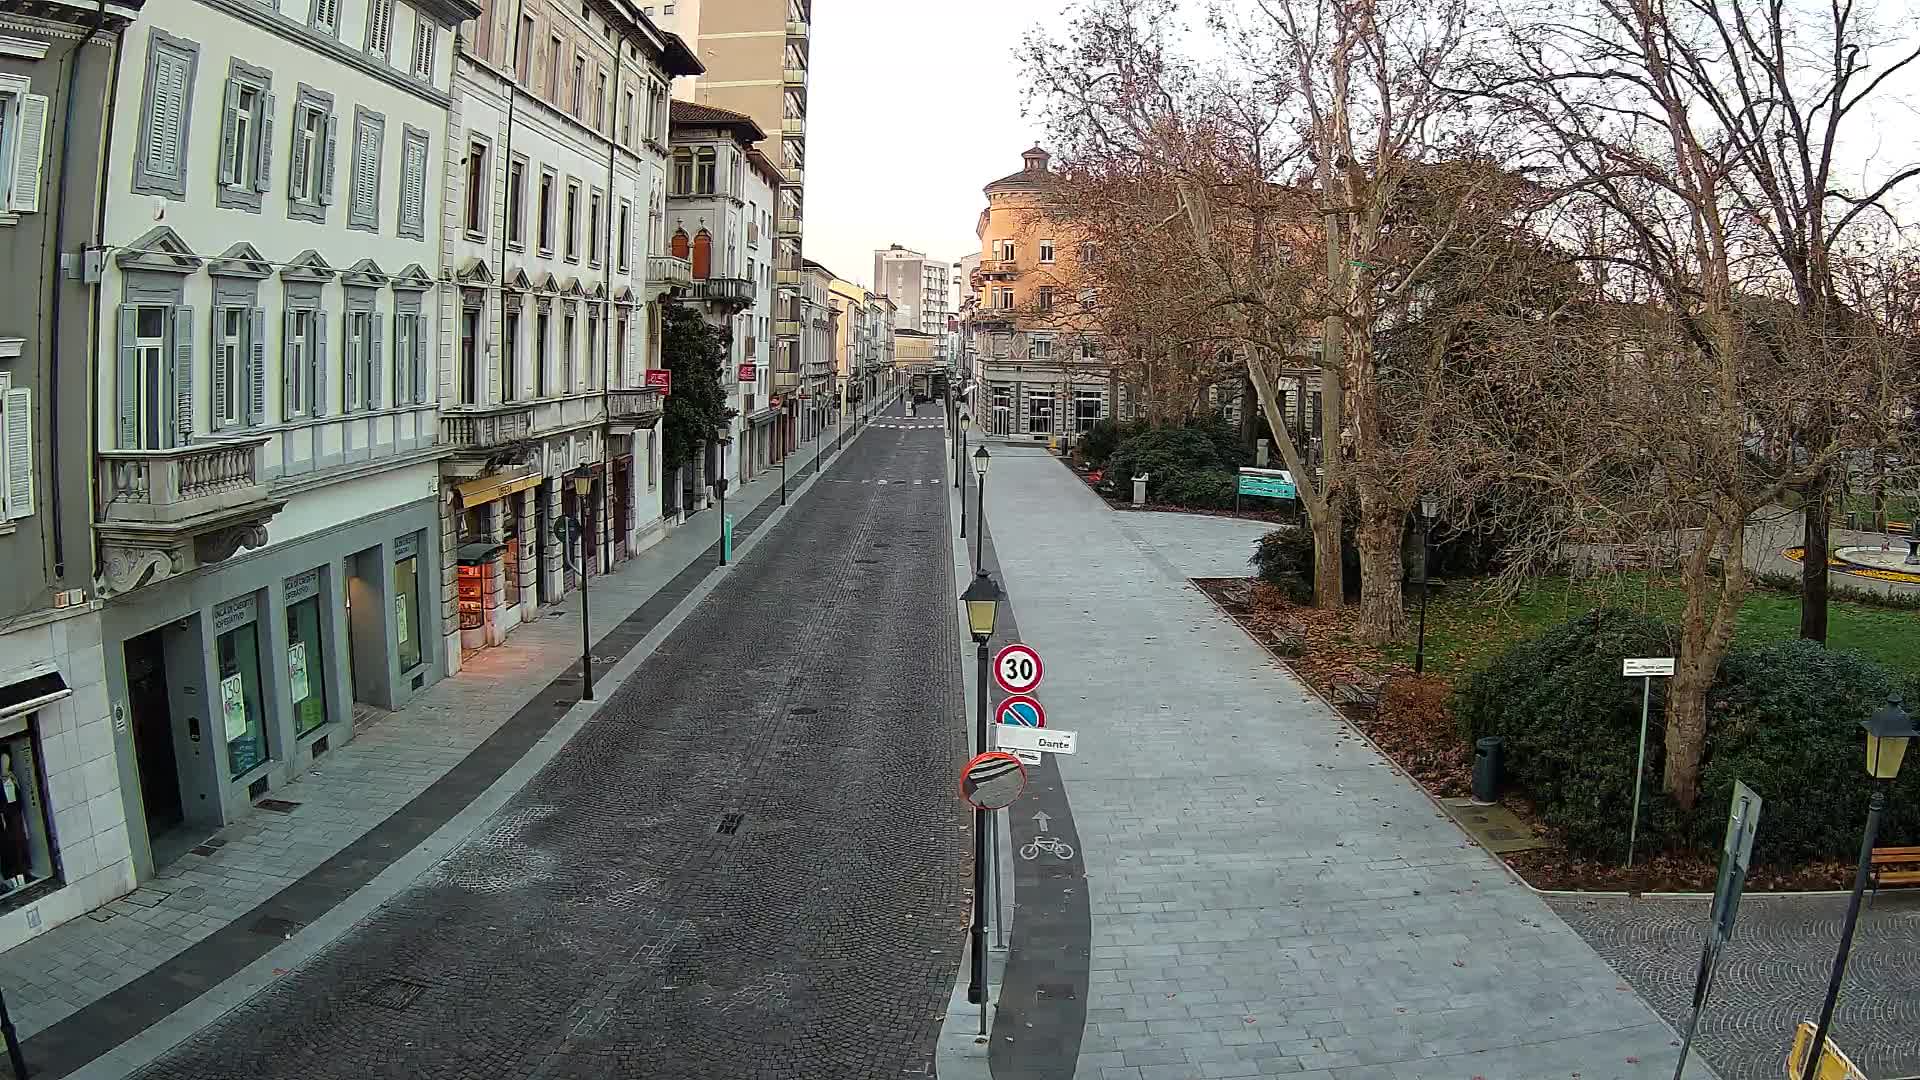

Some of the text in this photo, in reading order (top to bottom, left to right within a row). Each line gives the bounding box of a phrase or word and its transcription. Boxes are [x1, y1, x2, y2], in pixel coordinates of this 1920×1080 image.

[1006, 659, 1033, 680] 30
[222, 677, 240, 701] 130
[1038, 738, 1069, 749] Dante
